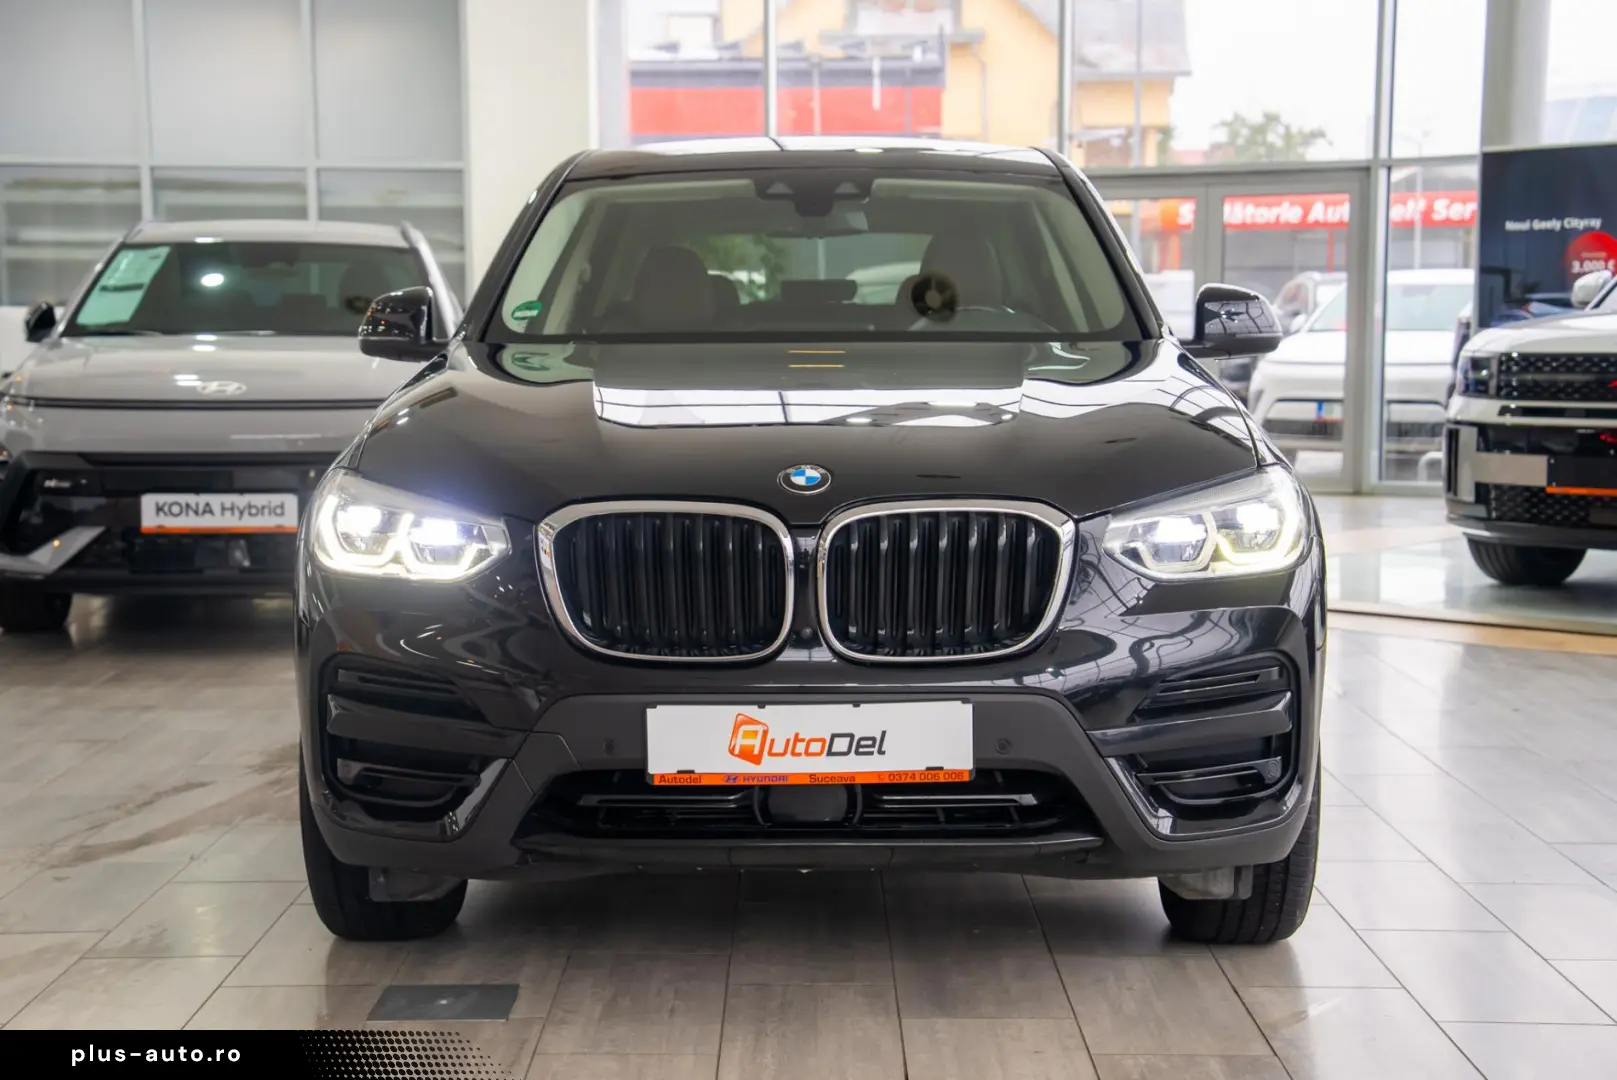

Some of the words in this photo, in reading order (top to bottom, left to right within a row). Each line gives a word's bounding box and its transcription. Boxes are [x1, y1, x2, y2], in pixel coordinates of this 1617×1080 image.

[1177, 200, 1303, 225] Slătorie
[1308, 199, 1350, 223] Aut
[1389, 197, 1427, 222] elf
[1532, 218, 1562, 232] Geely
[155, 501, 215, 518] KONA
[220, 500, 286, 521] Hybrid
[731, 724, 887, 758] AutoDel
[658, 774, 702, 784] Autodel
[742, 774, 789, 783] HYUNDAI
[808, 774, 856, 784] Suceava
[888, 772, 917, 782] 0374
[919, 772, 941, 781] 006
[943, 771, 965, 781] 006
